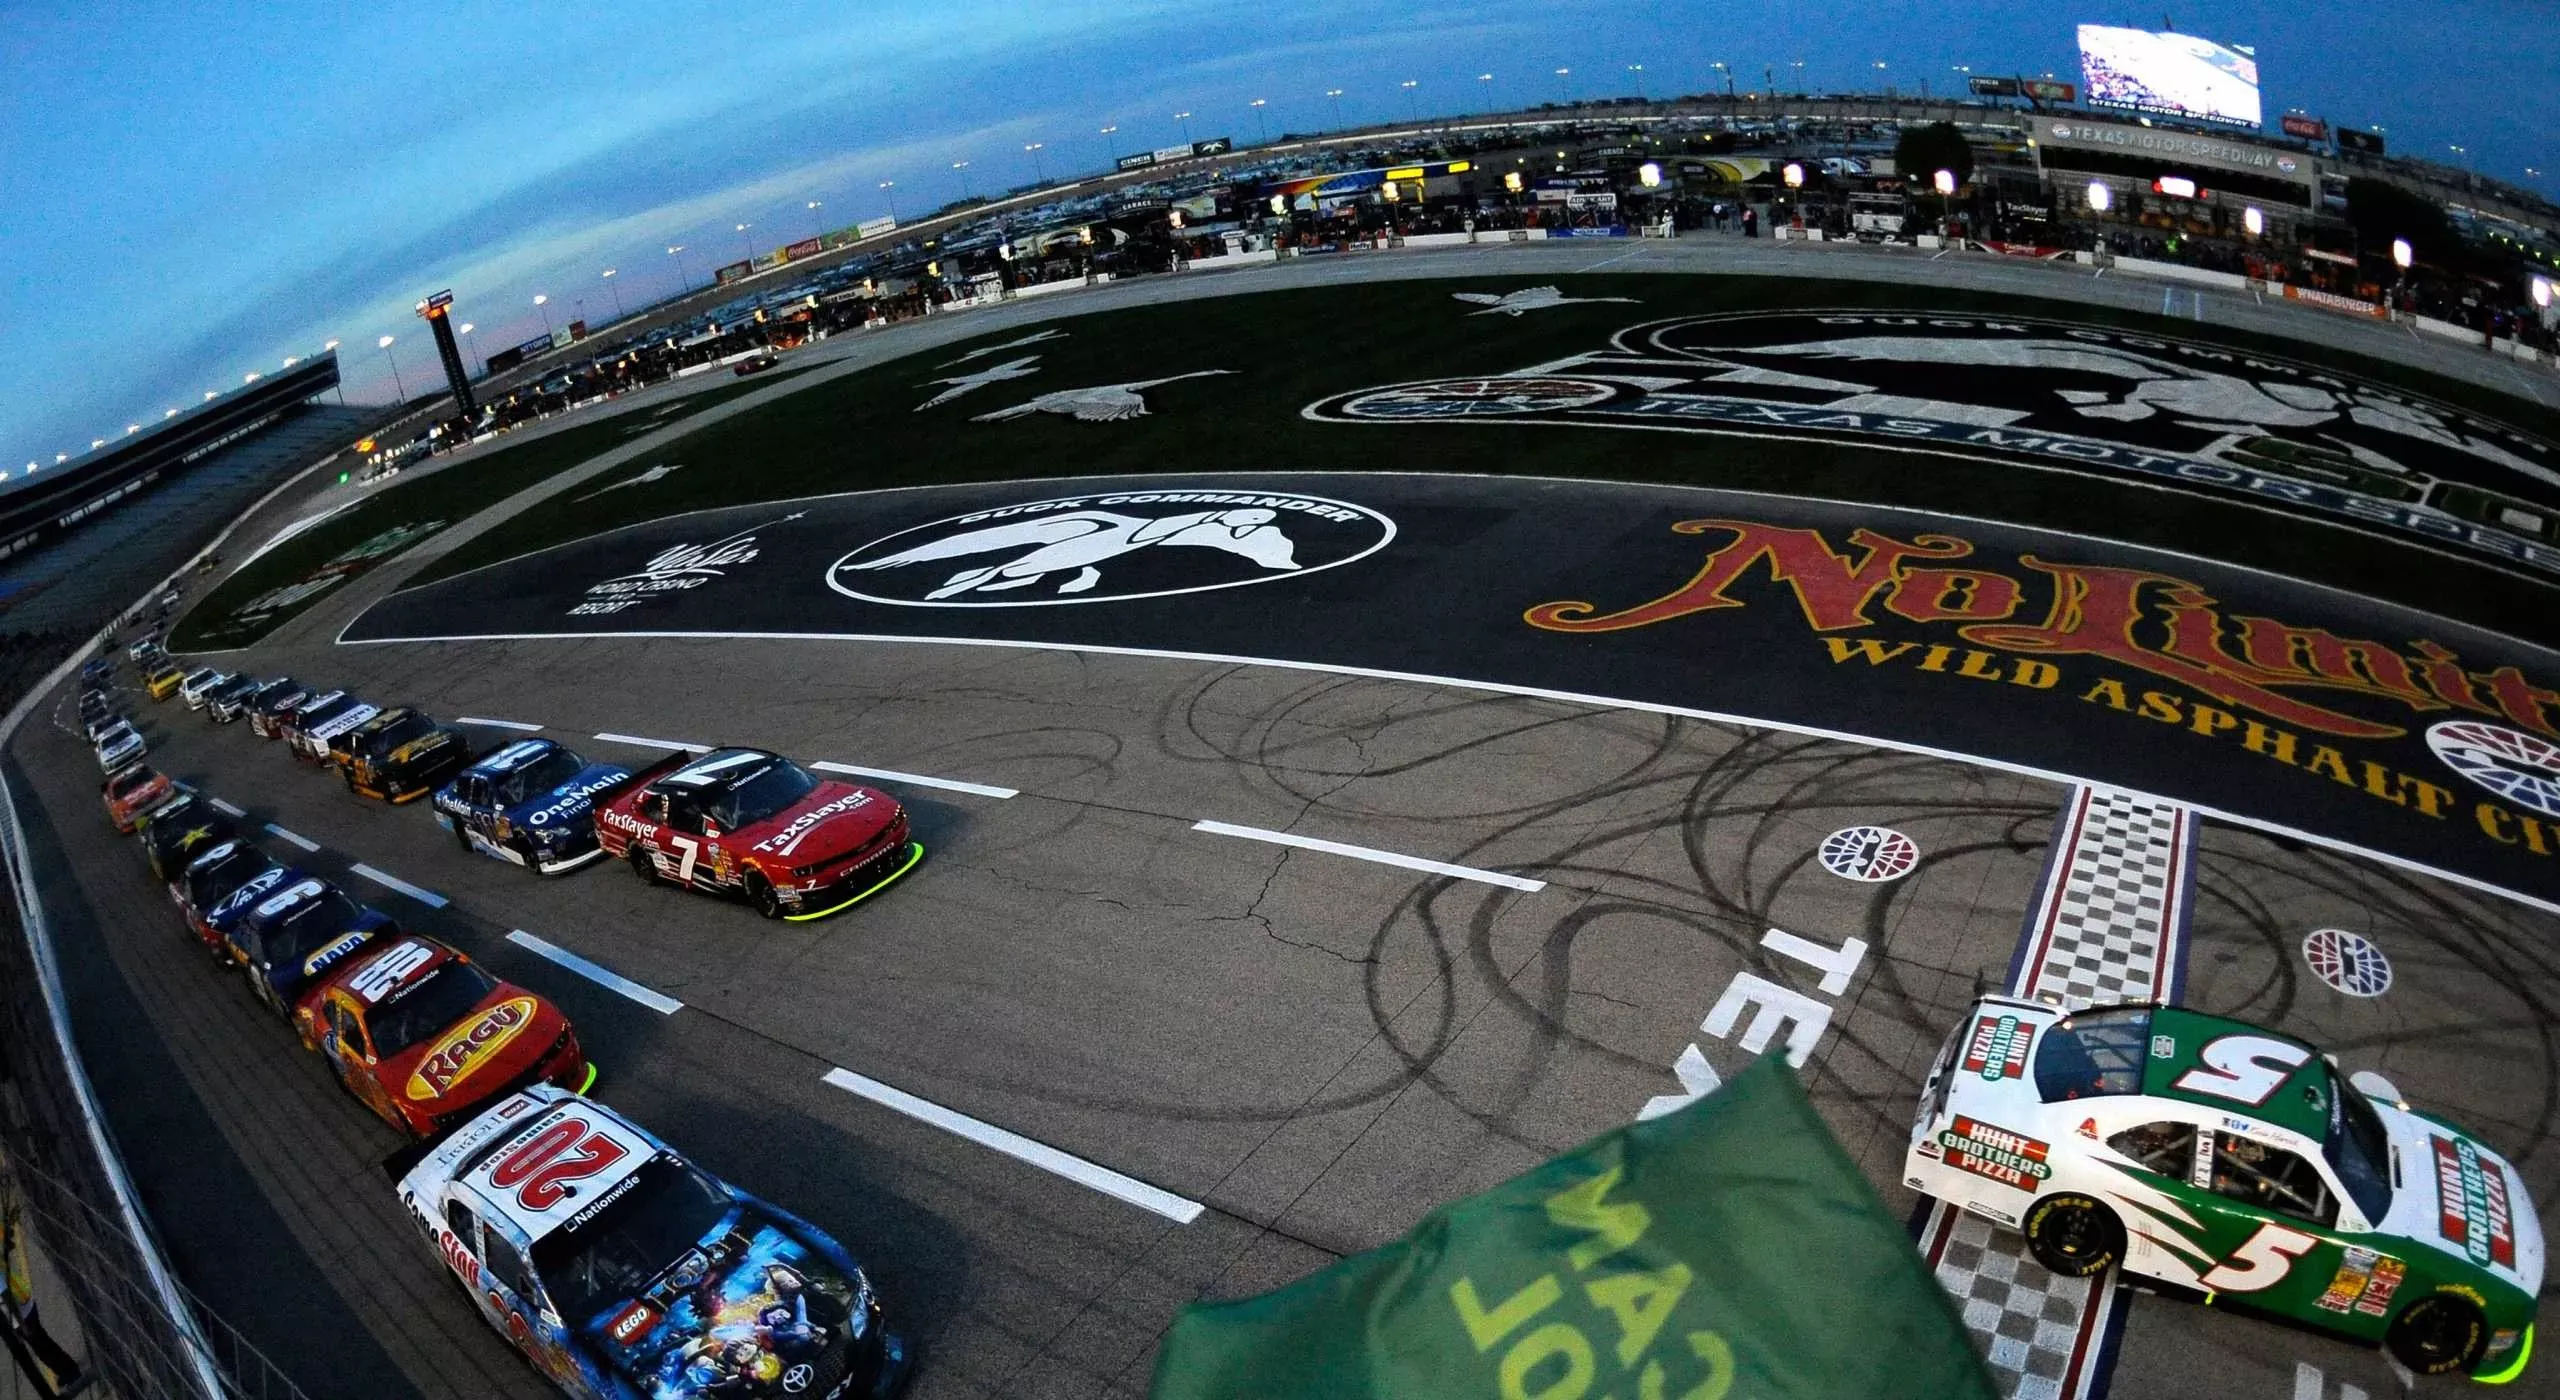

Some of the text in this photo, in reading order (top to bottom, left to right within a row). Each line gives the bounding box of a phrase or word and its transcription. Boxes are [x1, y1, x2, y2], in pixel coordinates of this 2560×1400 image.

[2098, 99, 2249, 127] TEXAS MOTOR SPEEDWAY
[1120, 155, 1151, 166] CINCH
[2074, 126, 2274, 168] TEXAS MOTOR SPEEDWAY
[2297, 287, 2377, 314] WHATABURGER
[1817, 317, 2548, 453] DUCK COMMANDER
[1634, 399, 1941, 435] TEXAS
[1969, 430, 2316, 500] MOTOR
[959, 494, 1358, 524] DUCK COMMANDER
[1818, 636, 2061, 690] WILD
[2080, 677, 2455, 820] ASPHALT
[530, 771, 629, 825] OneMain
[733, 765, 772, 790] Nationwide
[603, 808, 658, 839] TaxSlayer
[752, 788, 867, 851] TaxSlayer
[671, 836, 699, 881] 7
[839, 842, 895, 877] CAMARO
[806, 879, 817, 891] 7
[311, 934, 367, 972] NAPA
[395, 968, 440, 999] Nationwide
[1970, 1025, 1996, 1062] PIZZA
[1984, 1016, 2017, 1079] BROTHERS
[2009, 1031, 2028, 1067] HUNT
[2172, 1035, 2315, 1107] 5
[479, 1112, 566, 1172] GameStop
[1943, 1133, 2047, 1179] BROTHERS
[1970, 1123, 2030, 1156] HUNT
[489, 1117, 630, 1212] 20
[1961, 1153, 2022, 1185] PIZZA
[574, 1173, 640, 1226] Nationwide
[2438, 1152, 2467, 1221] HUNT
[2456, 1142, 2490, 1262] BROTHERS
[2484, 1173, 2511, 1243] PIZZA
[2200, 1222, 2319, 1291] 5
[614, 1305, 651, 1341] LEGO
